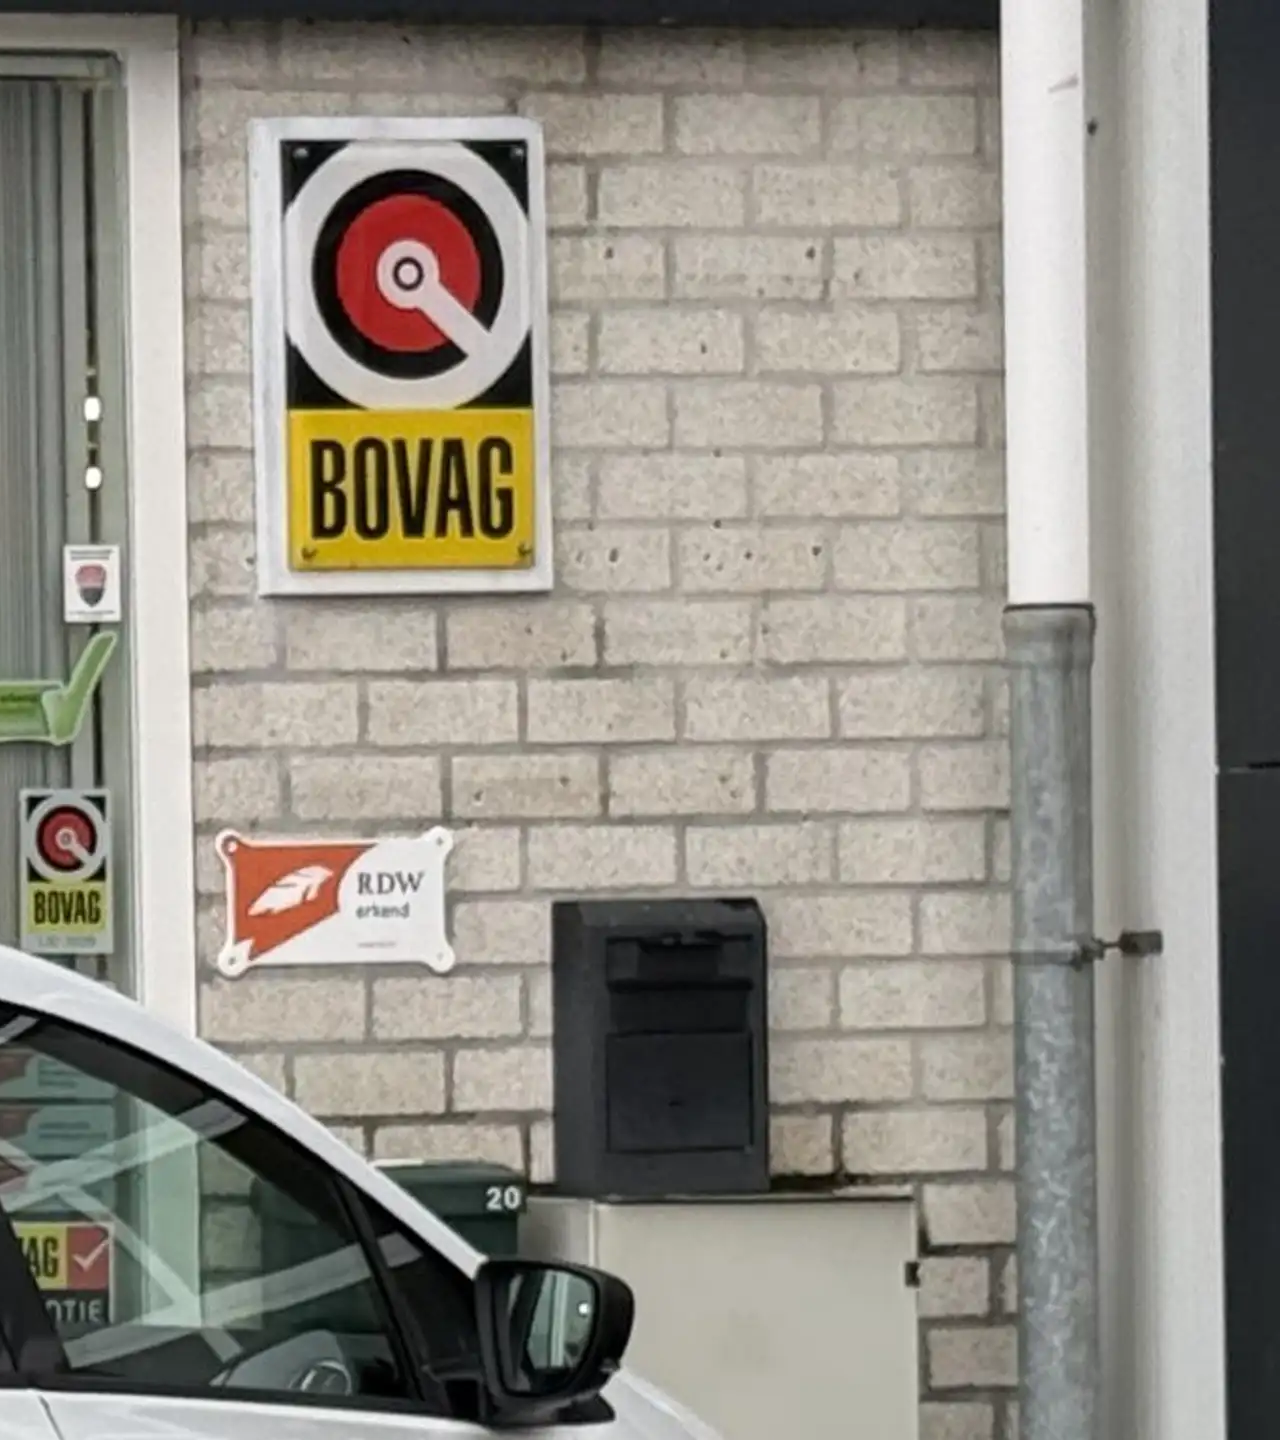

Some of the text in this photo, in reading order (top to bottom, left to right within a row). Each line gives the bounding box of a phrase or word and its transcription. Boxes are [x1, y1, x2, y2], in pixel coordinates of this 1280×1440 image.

[310, 436, 514, 540] BOVAG
[356, 870, 426, 896] RDW
[33, 889, 102, 925] BOVAG
[355, 903, 410, 919] erkend
[486, 1185, 521, 1211] 20
